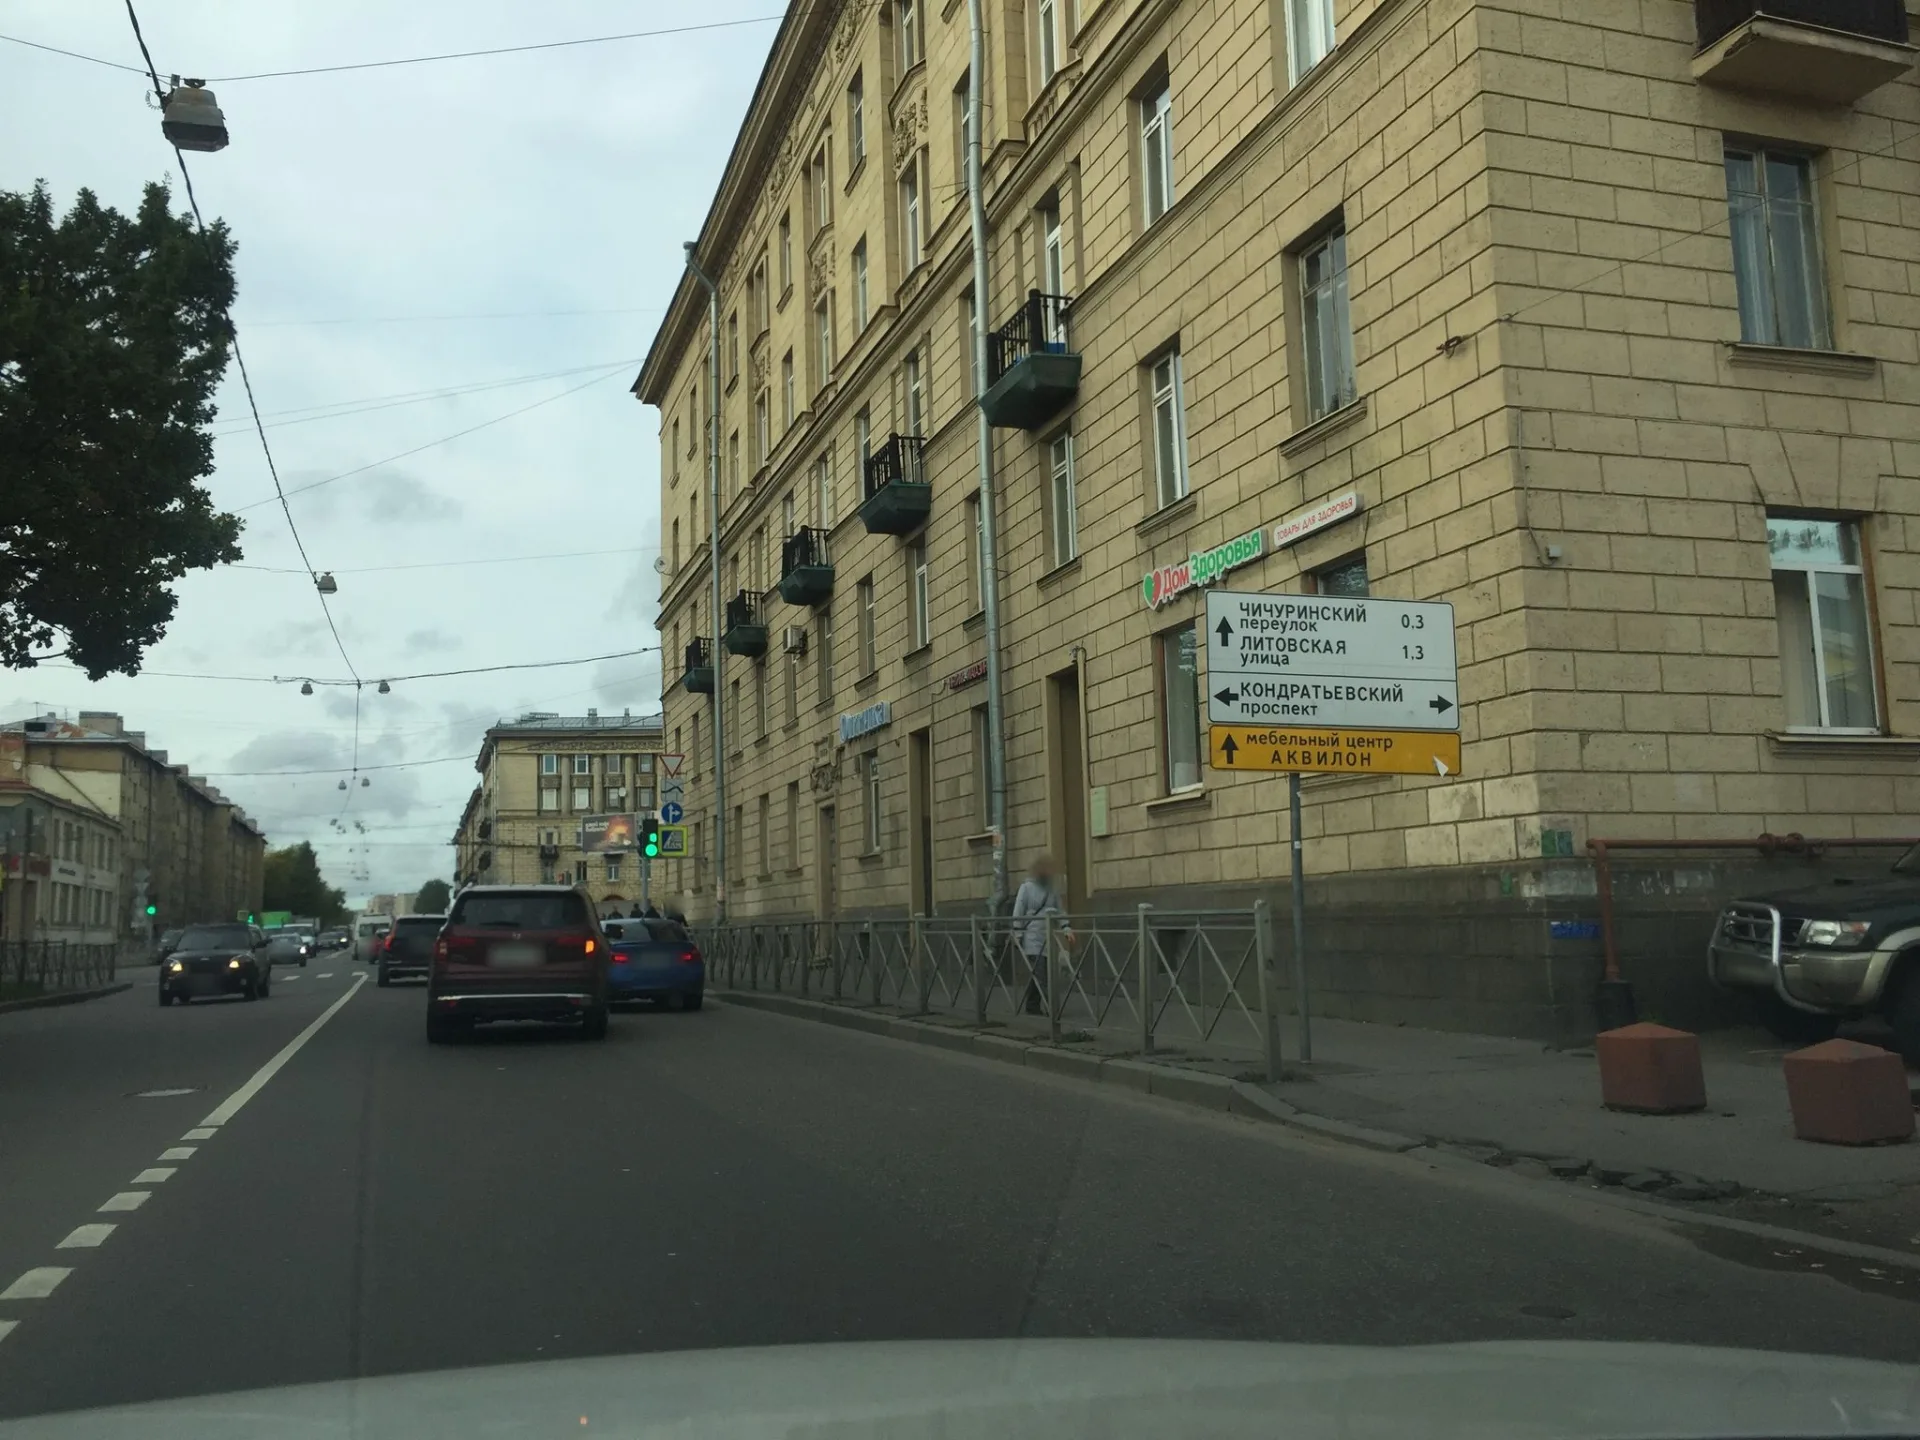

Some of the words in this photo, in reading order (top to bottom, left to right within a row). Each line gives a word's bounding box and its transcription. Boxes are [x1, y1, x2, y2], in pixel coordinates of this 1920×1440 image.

[1276, 522, 1301, 541] ТОВАРЫ
[1302, 514, 1317, 530] ДЛЯ
[1317, 497, 1354, 524] ЗДОРОВЬЯ
[1162, 565, 1190, 595] Дом
[1190, 530, 1262, 579] Здоровья
[1240, 602, 1367, 623] ЧИЧУРИНСКИЙ
[1240, 617, 1318, 634] переулок
[1240, 635, 1347, 655] ЛИТОВСКАЯ
[1240, 651, 1290, 667] улица
[1240, 682, 1404, 703] КОНДРАТЬЕВСКИЙ
[1240, 702, 1319, 718] проспект
[1246, 732, 1340, 748] мебельный
[1346, 735, 1393, 751] центр
[1271, 750, 1372, 767] АКВИЛОН
